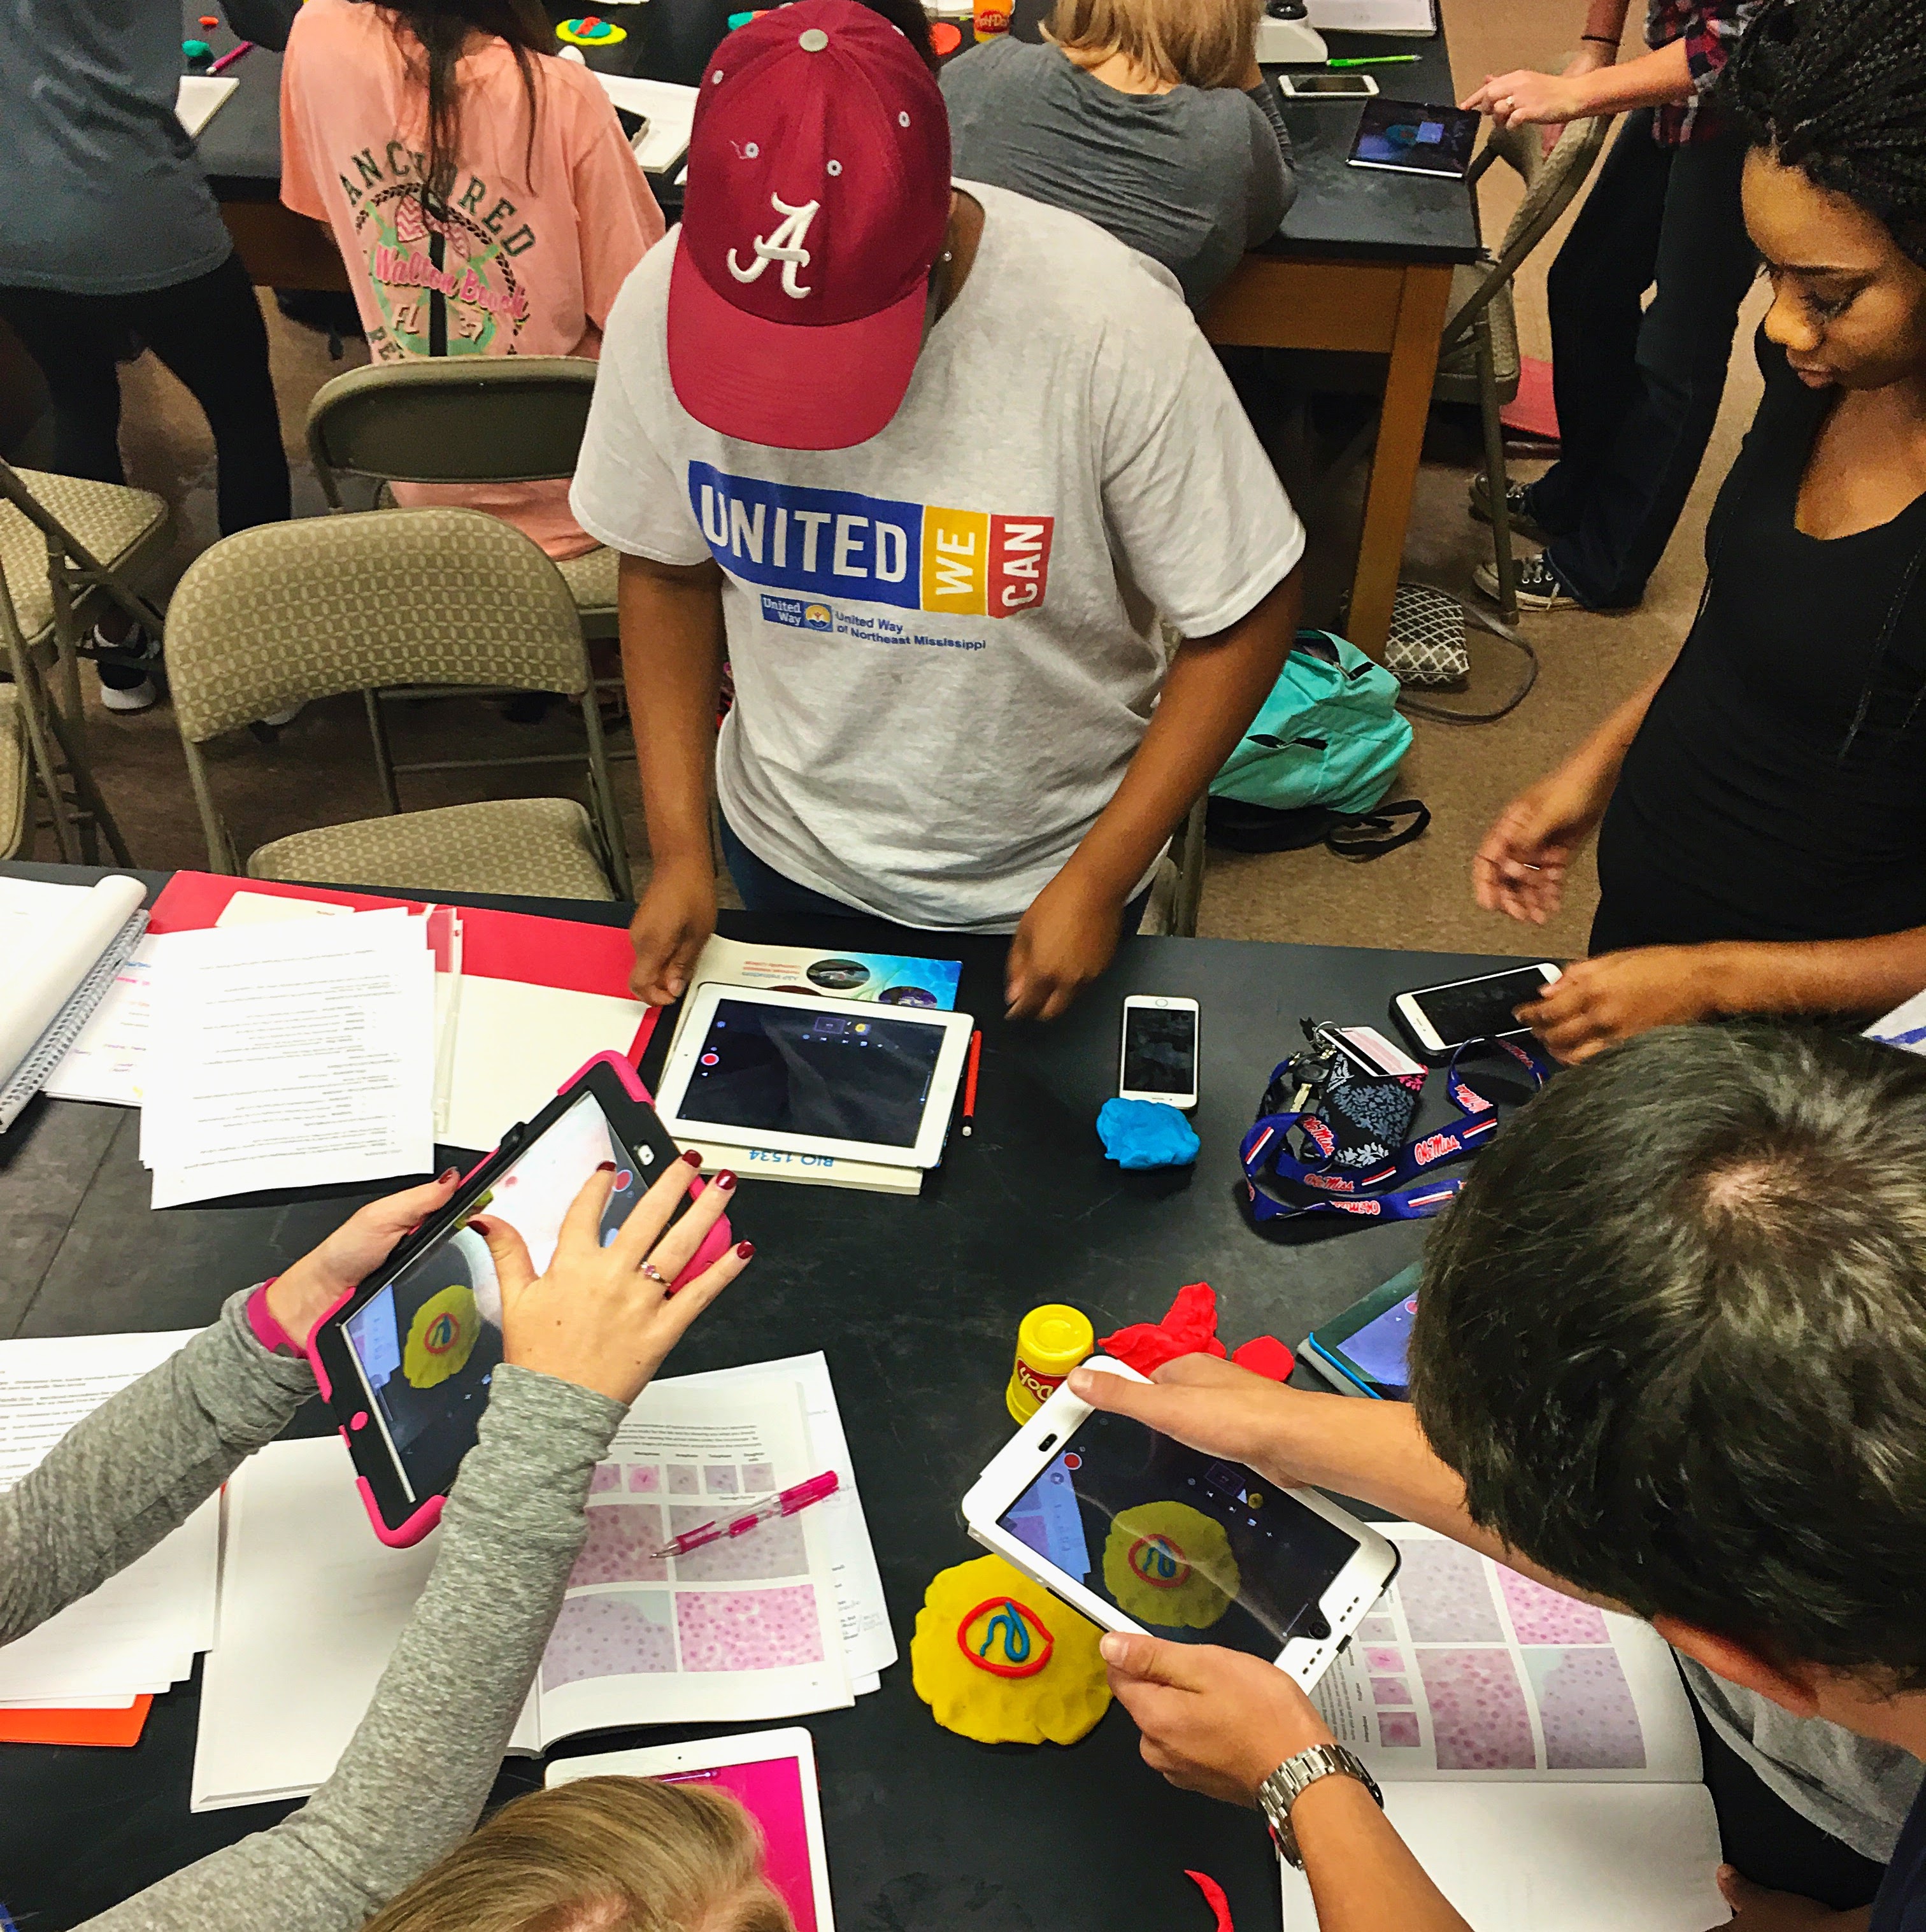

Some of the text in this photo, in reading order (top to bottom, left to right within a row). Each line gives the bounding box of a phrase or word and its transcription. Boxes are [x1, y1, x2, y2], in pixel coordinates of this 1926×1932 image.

[339, 139, 536, 257] ANCRED
[727, 191, 821, 299] A
[701, 484, 1045, 607] UNITED WE CAN
[763, 597, 802, 613] United
[778, 611, 801, 626] Way
[835, 610, 904, 634] United Way
[837, 625, 987, 651] of Northeast Mississippi
[749, 1149, 792, 1163] 1534
[1415, 1133, 1460, 1165] Ole Miss
[1324, 1176, 1354, 1192] Miss
[1020, 1367, 1054, 1402] Doh
